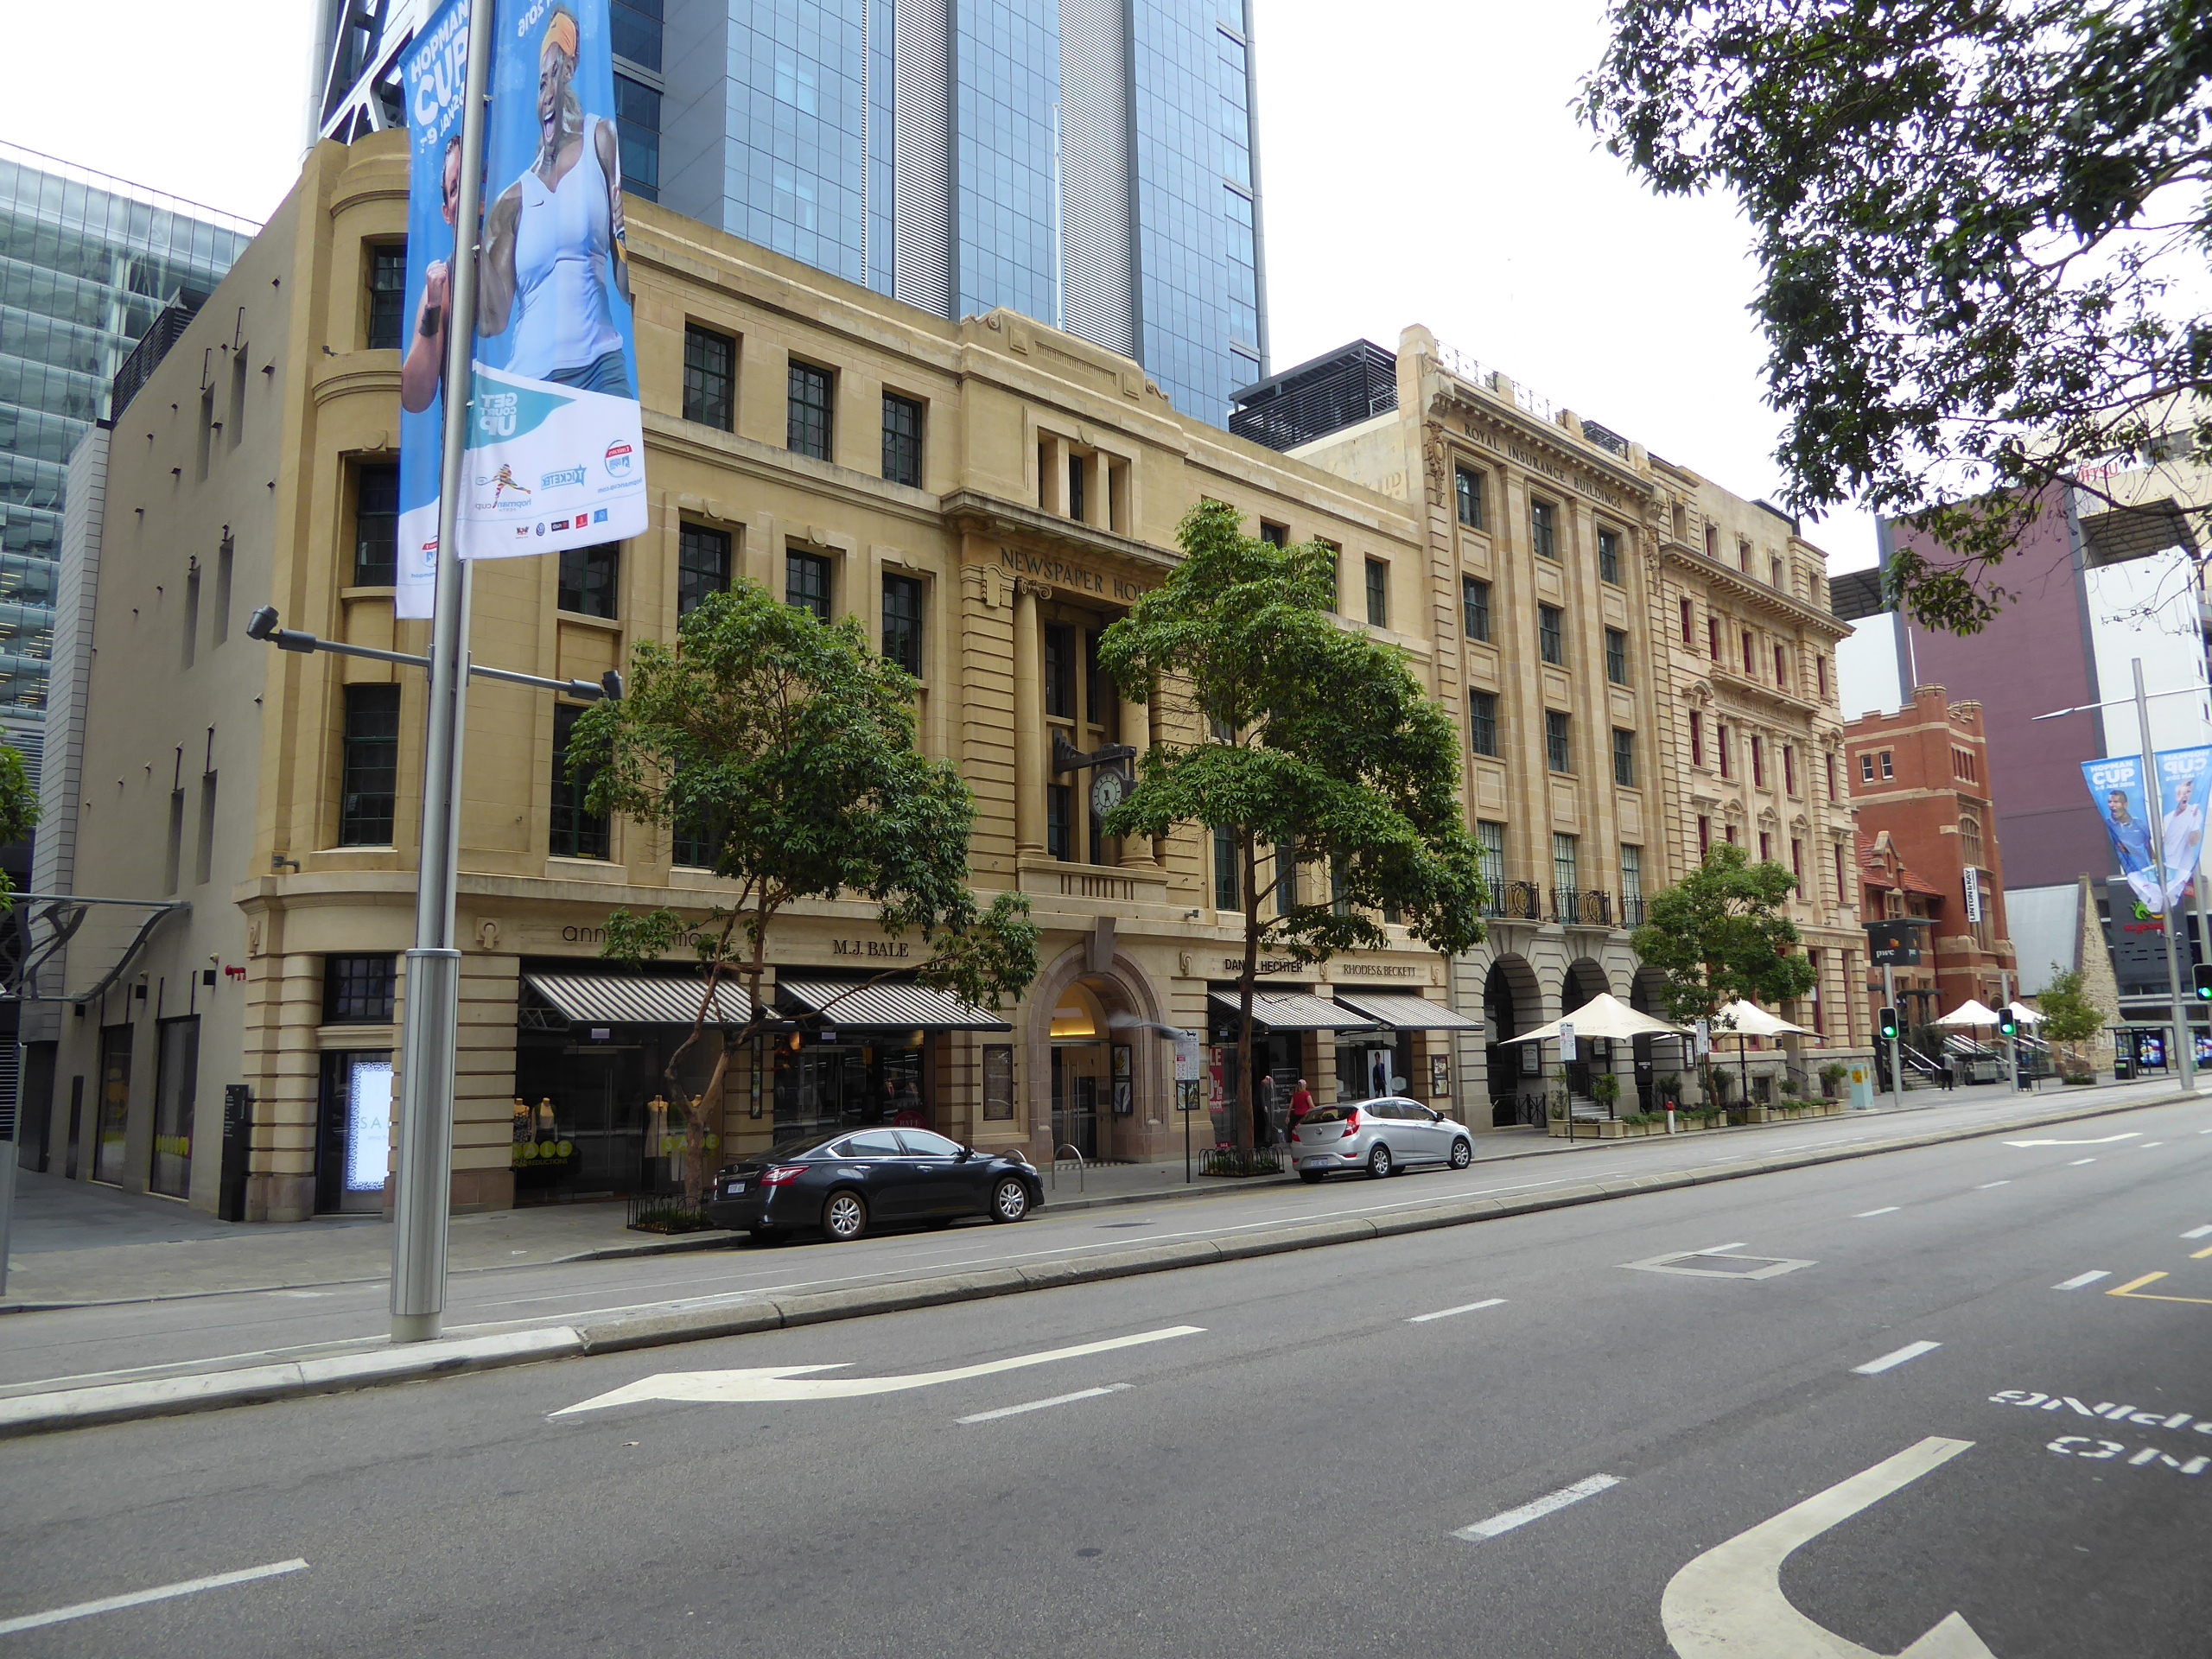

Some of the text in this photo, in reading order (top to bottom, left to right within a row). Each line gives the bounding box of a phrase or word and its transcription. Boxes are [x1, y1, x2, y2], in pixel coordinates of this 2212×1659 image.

[410, 0, 469, 83] HOPMAN
[415, 26, 468, 126] CUP
[1464, 423, 1623, 510] ROYAL INSURANCE BUILDINGS
[1001, 547, 1149, 601] NEWSPAPER HOU
[2090, 760, 2134, 772] HOPMAN
[2092, 767, 2135, 785] CUP
[563, 925, 607, 943] ann
[833, 939, 909, 957] M.J. BALE
[1876, 949, 1896, 958] pwc
[1261, 959, 1303, 973] HECHTER
[1344, 963, 1416, 976] RHODES & BECKETT
